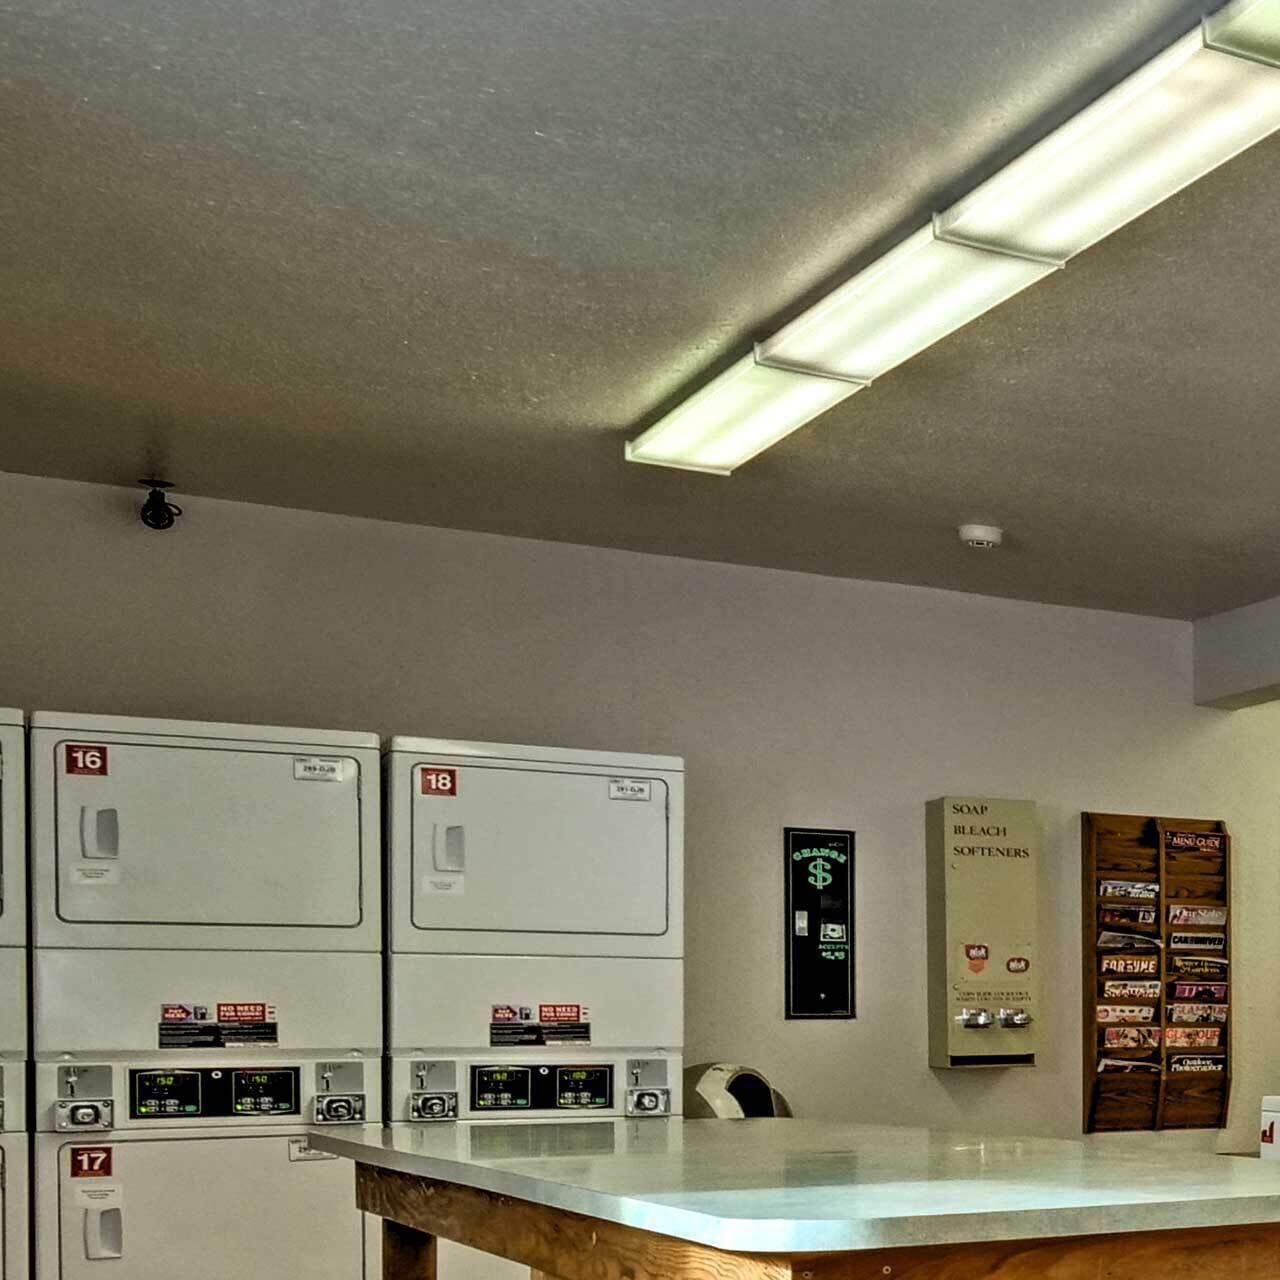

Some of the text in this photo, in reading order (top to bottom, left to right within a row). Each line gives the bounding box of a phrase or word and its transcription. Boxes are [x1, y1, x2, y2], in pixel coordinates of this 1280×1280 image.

[72, 751, 102, 768] 16
[426, 774, 452, 790] 18
[952, 803, 988, 815] SOAP
[953, 825, 1007, 837] BLEACH
[793, 848, 847, 863] CHANGE
[953, 846, 1029, 858] SOFTENERS
[808, 858, 833, 889] $
[77, 1153, 107, 1171] 17
